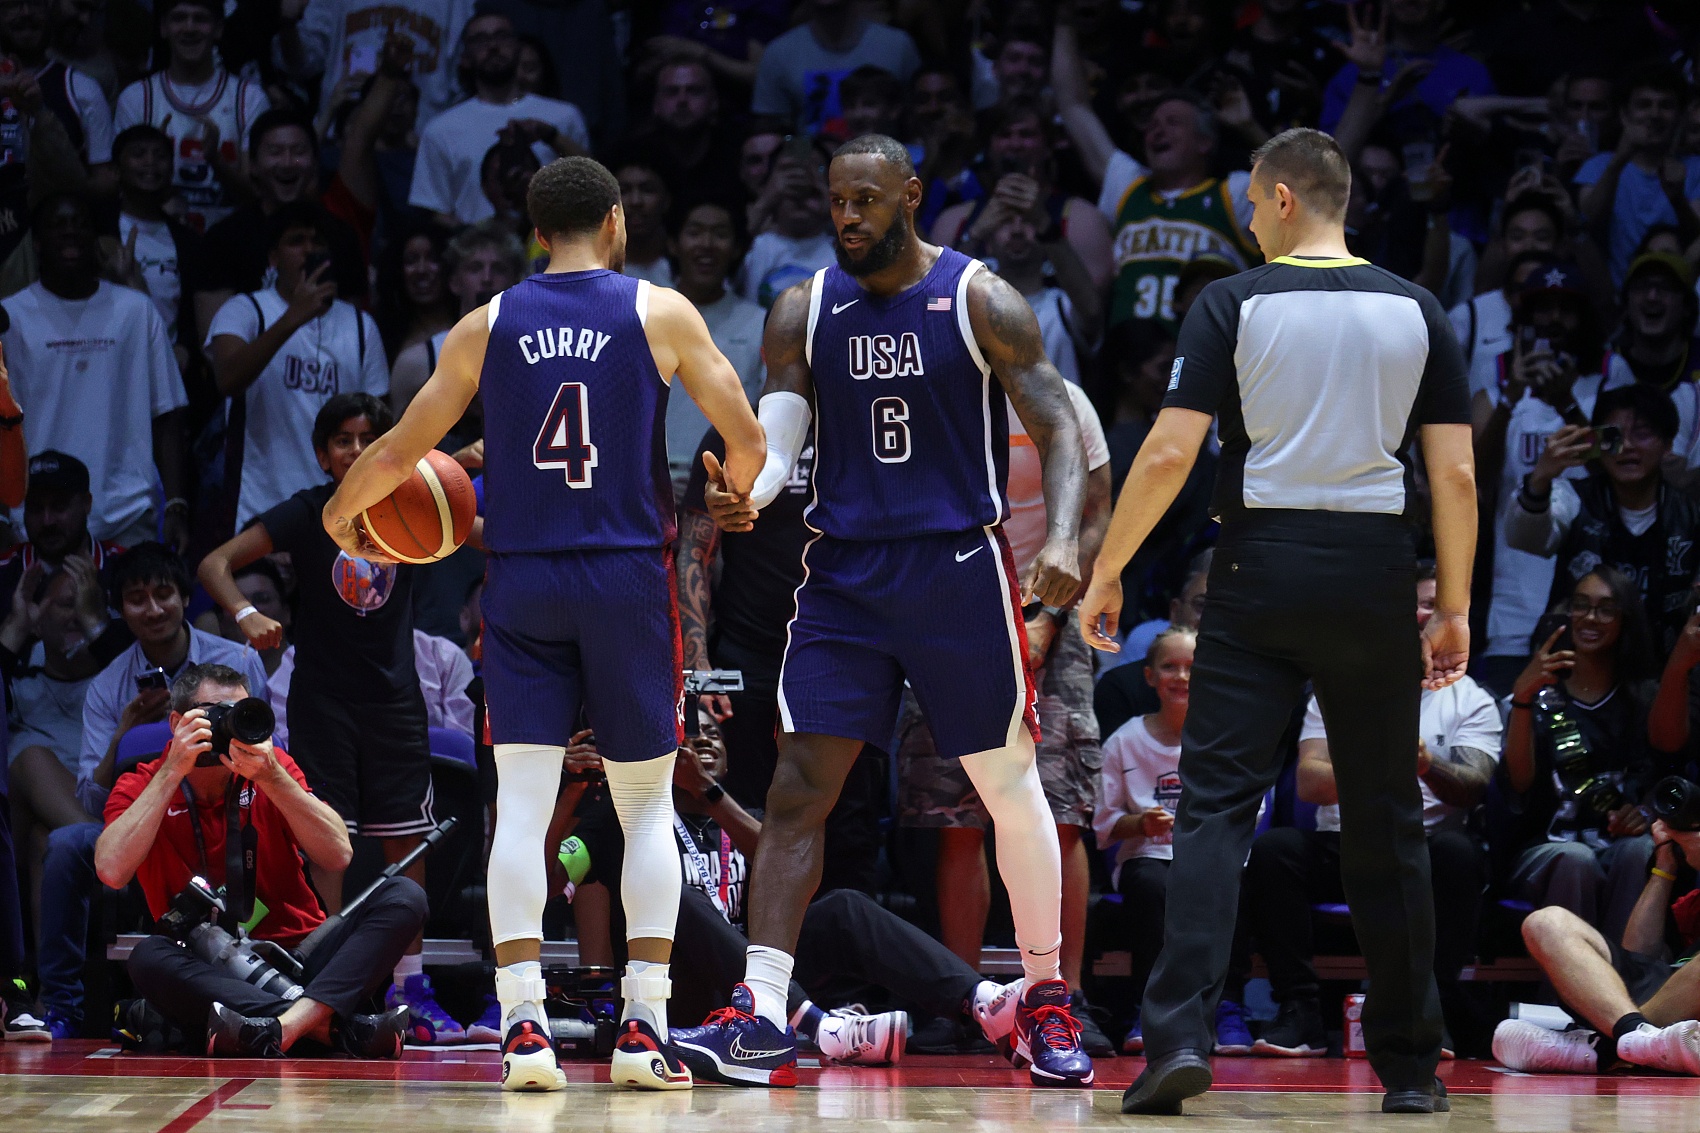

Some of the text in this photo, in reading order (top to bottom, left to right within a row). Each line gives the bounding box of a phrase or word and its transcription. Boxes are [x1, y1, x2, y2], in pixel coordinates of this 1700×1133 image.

[518, 327, 612, 365] CURRY
[849, 332, 924, 380] USA
[284, 355, 338, 395] USA
[532, 382, 599, 490] 4
[871, 396, 912, 464] 6
[245, 849, 254, 869] EOS
[677, 822, 717, 898] USA BASKETBALL
